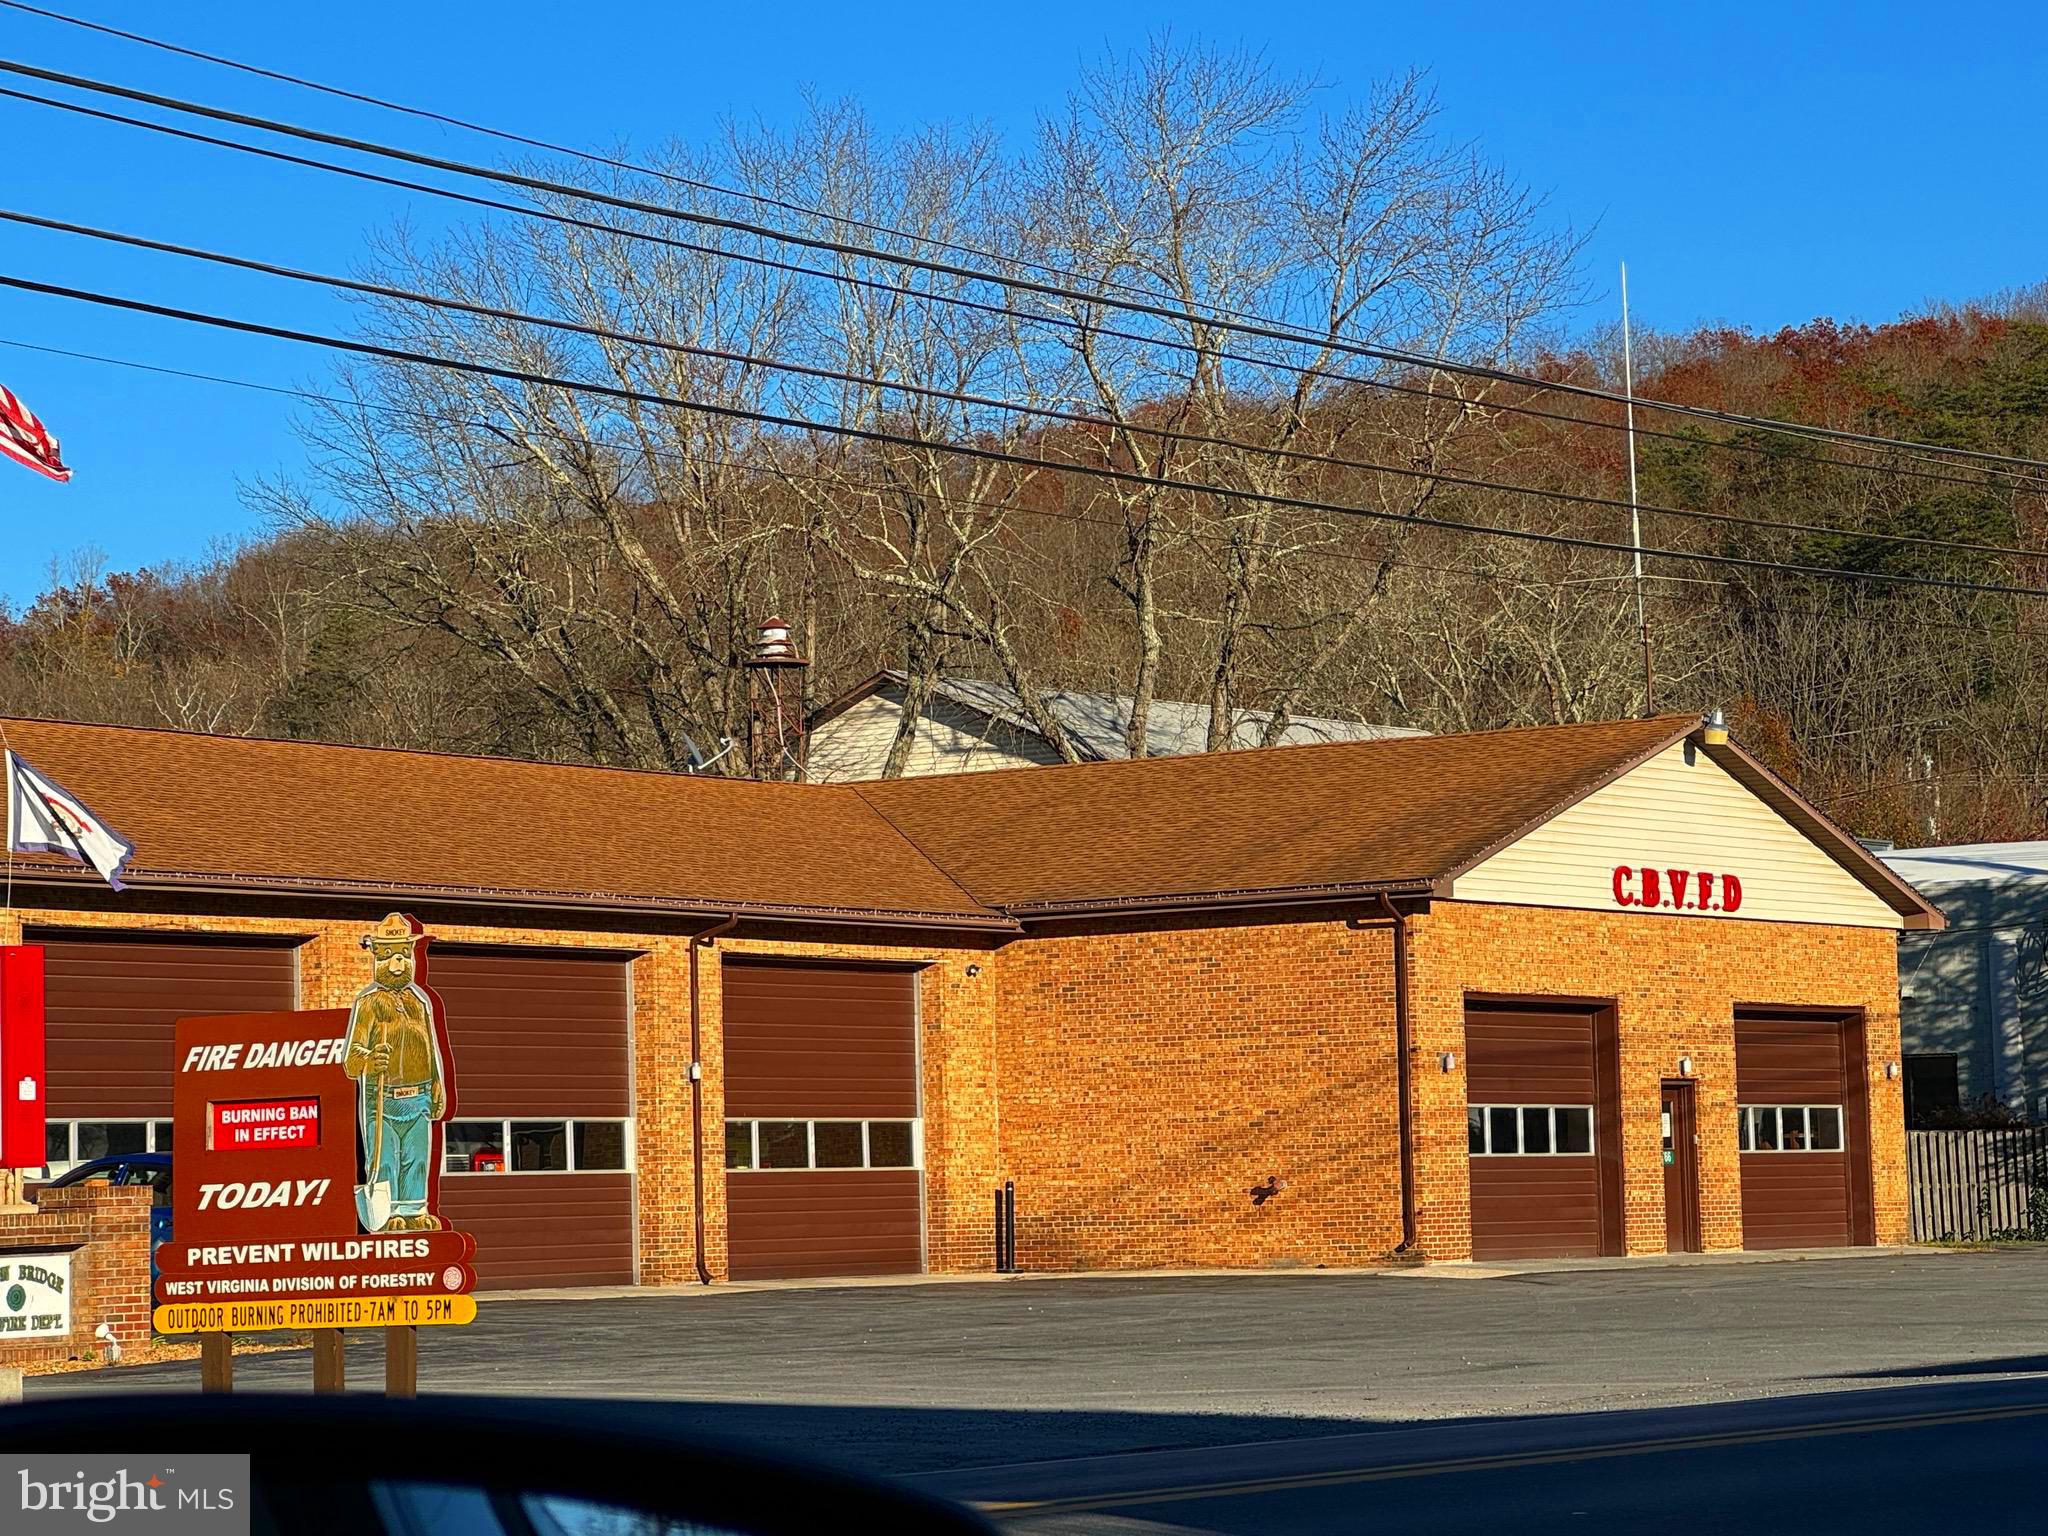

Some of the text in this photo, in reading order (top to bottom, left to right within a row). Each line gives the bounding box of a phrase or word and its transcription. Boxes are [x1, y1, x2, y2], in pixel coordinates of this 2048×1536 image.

[181, 1038, 347, 1073] FIRE DANGER
[221, 1104, 319, 1125] BURNING BAN
[234, 1125, 306, 1143] IN EFFECT
[197, 1178, 332, 1212] TODAY!
[187, 1239, 430, 1266] PREVENT WILDFIRES
[18, 1264, 64, 1294] BRIDGE
[165, 1280, 203, 1296] WEST
[207, 1278, 269, 1294] VIRGINIA
[272, 1275, 335, 1292] DIVISION
[339, 1275, 358, 1289] OF
[361, 1272, 436, 1289] FORESTRY
[168, 1307, 224, 1329] OUTDOOR
[231, 1303, 284, 1328] BURNING
[403, 1300, 419, 1322] TO
[426, 1298, 453, 1320] 5PM
